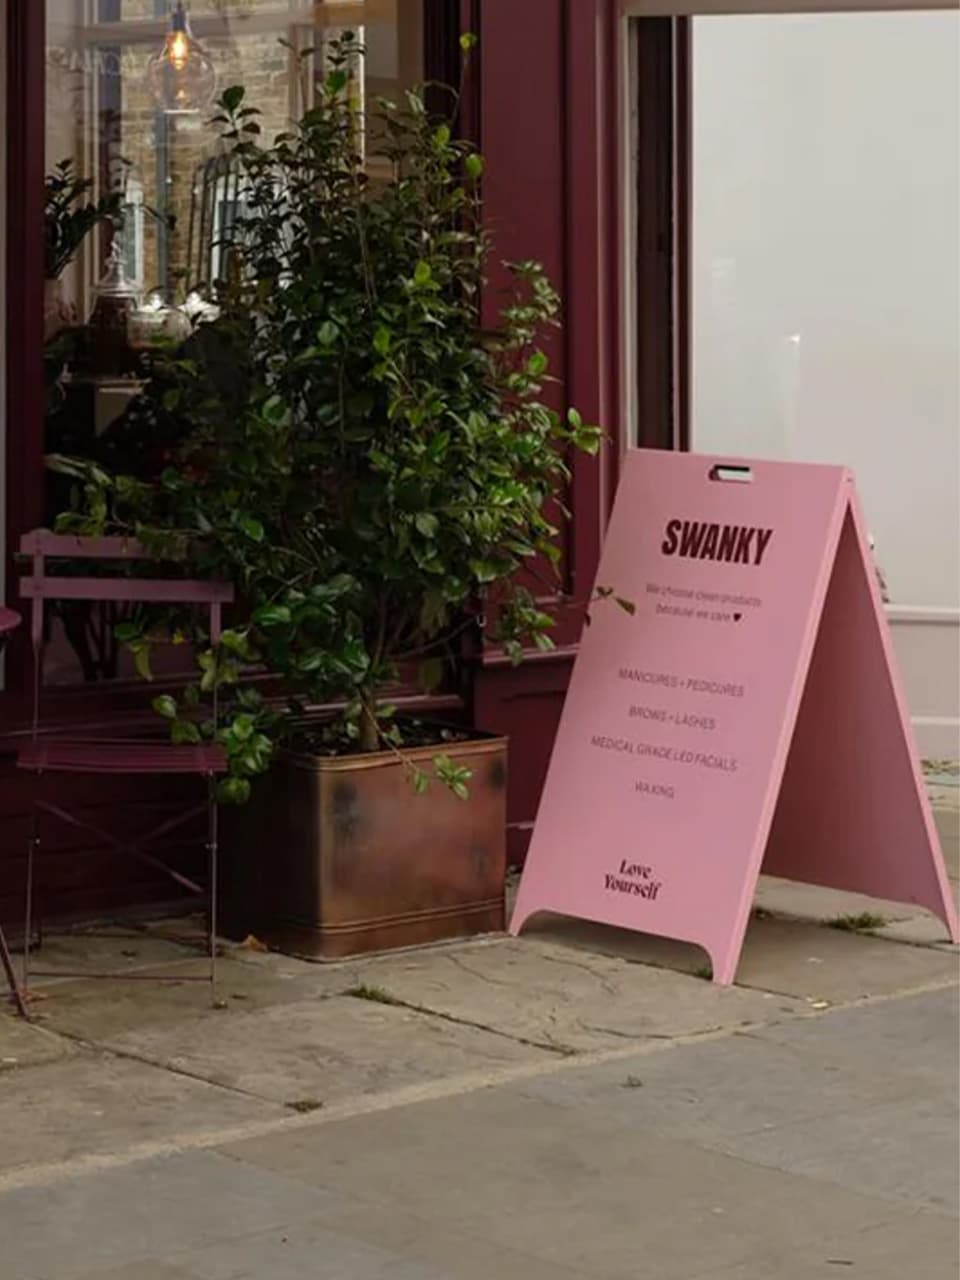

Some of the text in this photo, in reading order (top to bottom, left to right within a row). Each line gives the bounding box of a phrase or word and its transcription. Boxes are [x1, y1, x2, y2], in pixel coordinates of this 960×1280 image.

[661, 519, 773, 565] SWANKY
[618, 668, 744, 697] MANICURES PEDICURES
[628, 705, 716, 730] BROWS LASHES
[591, 735, 737, 771] MEDICAL GRADE LED FACIALS
[619, 859, 651, 879] Love
[605, 874, 662, 900] Yourself
